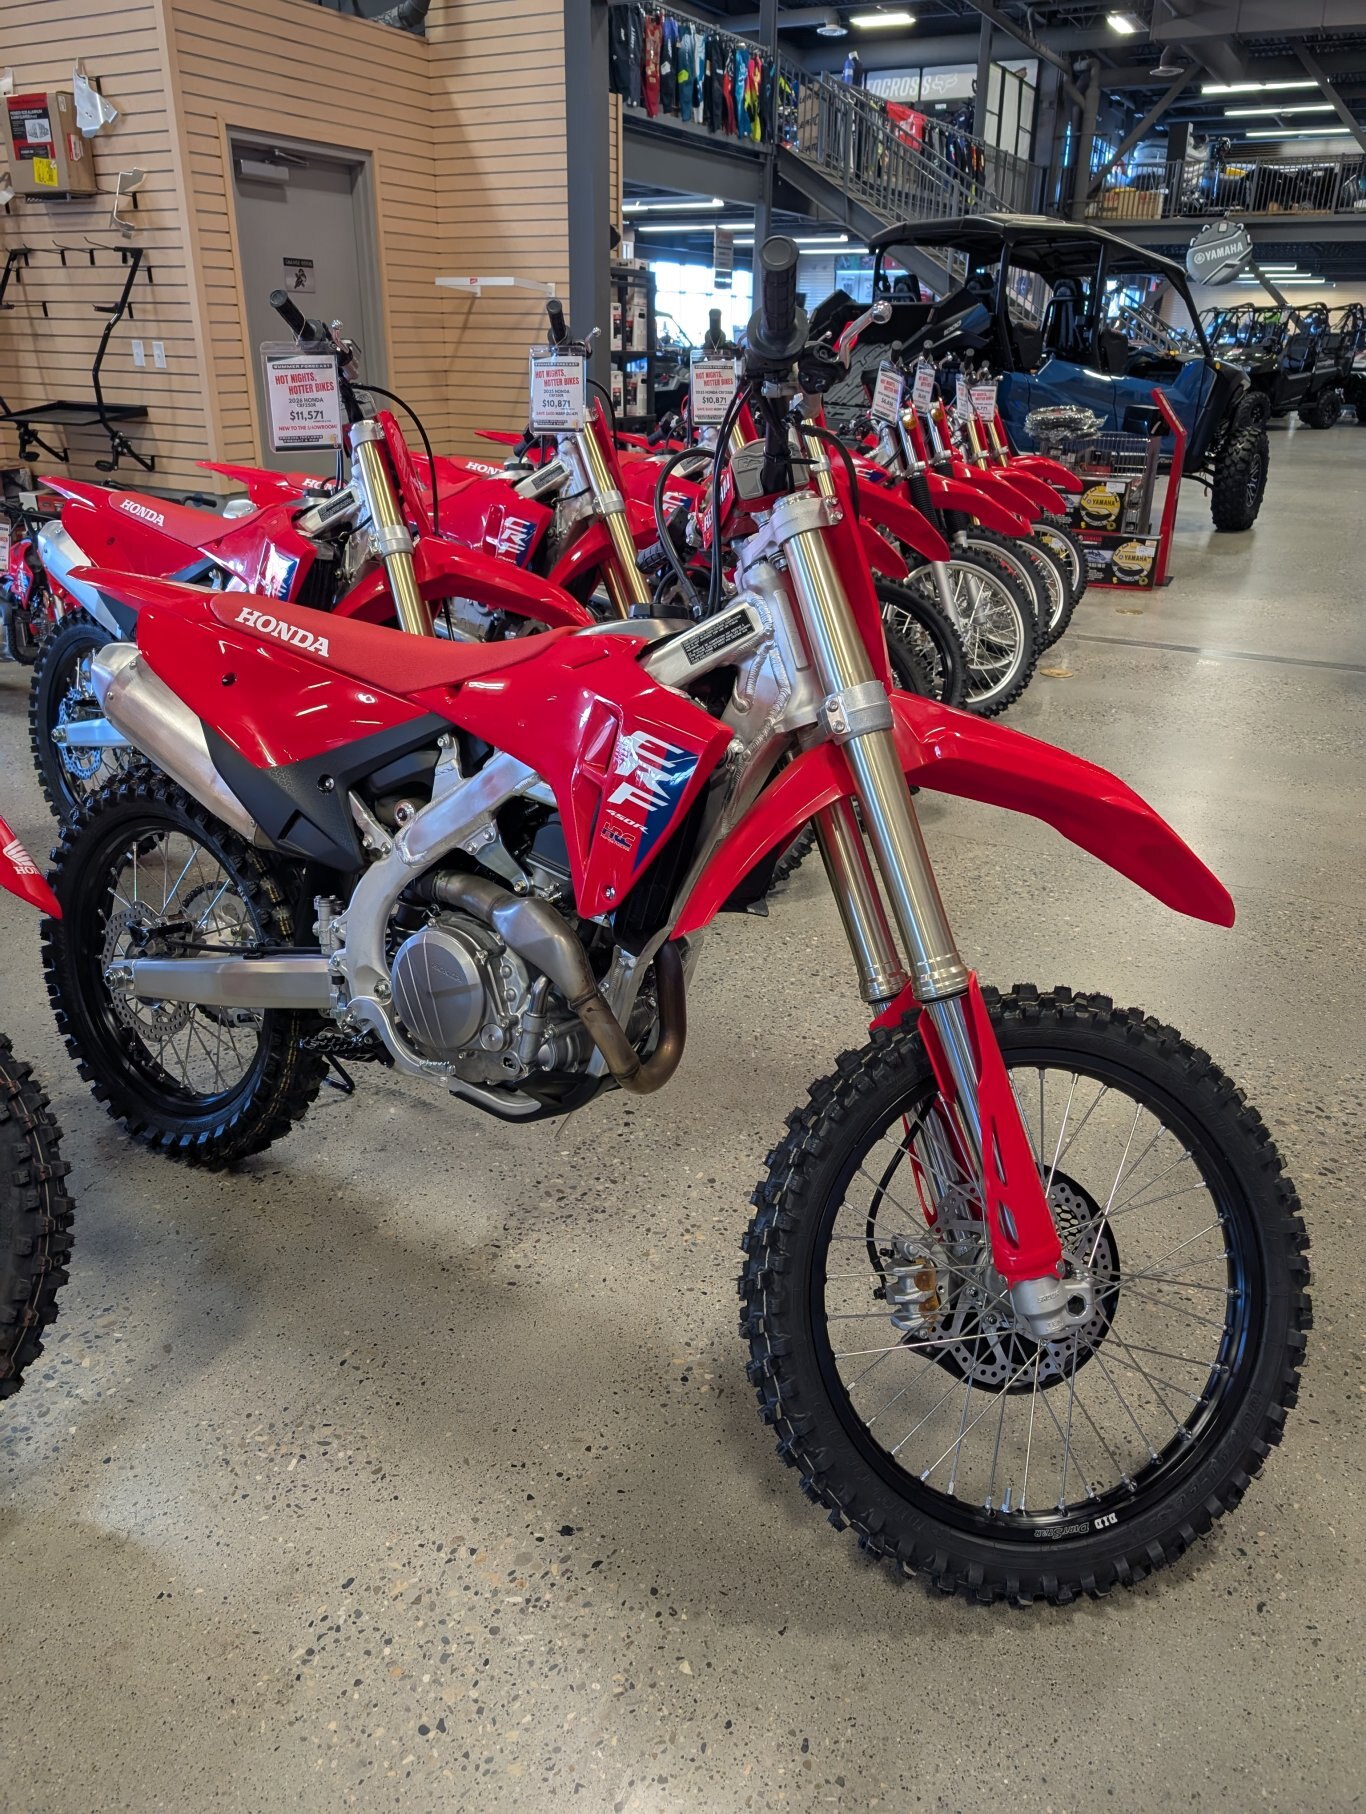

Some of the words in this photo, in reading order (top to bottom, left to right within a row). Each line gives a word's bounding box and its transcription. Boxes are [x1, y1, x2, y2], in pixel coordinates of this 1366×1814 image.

[1205, 242, 1243, 261] YAMAHA
[275, 374, 288, 384] HOT
[290, 372, 317, 383] NIGHTS,
[544, 378, 563, 387] HOTTER
[564, 377, 579, 386] BIKES
[288, 383, 314, 395] HOTTER
[316, 382, 334, 393] BIKES
[542, 399, 570, 408] $10,871
[290, 410, 324, 421] $11,571
[120, 499, 166, 527] HONDA
[235, 607, 329, 658] HONDA
[606, 809, 649, 835] 450R
